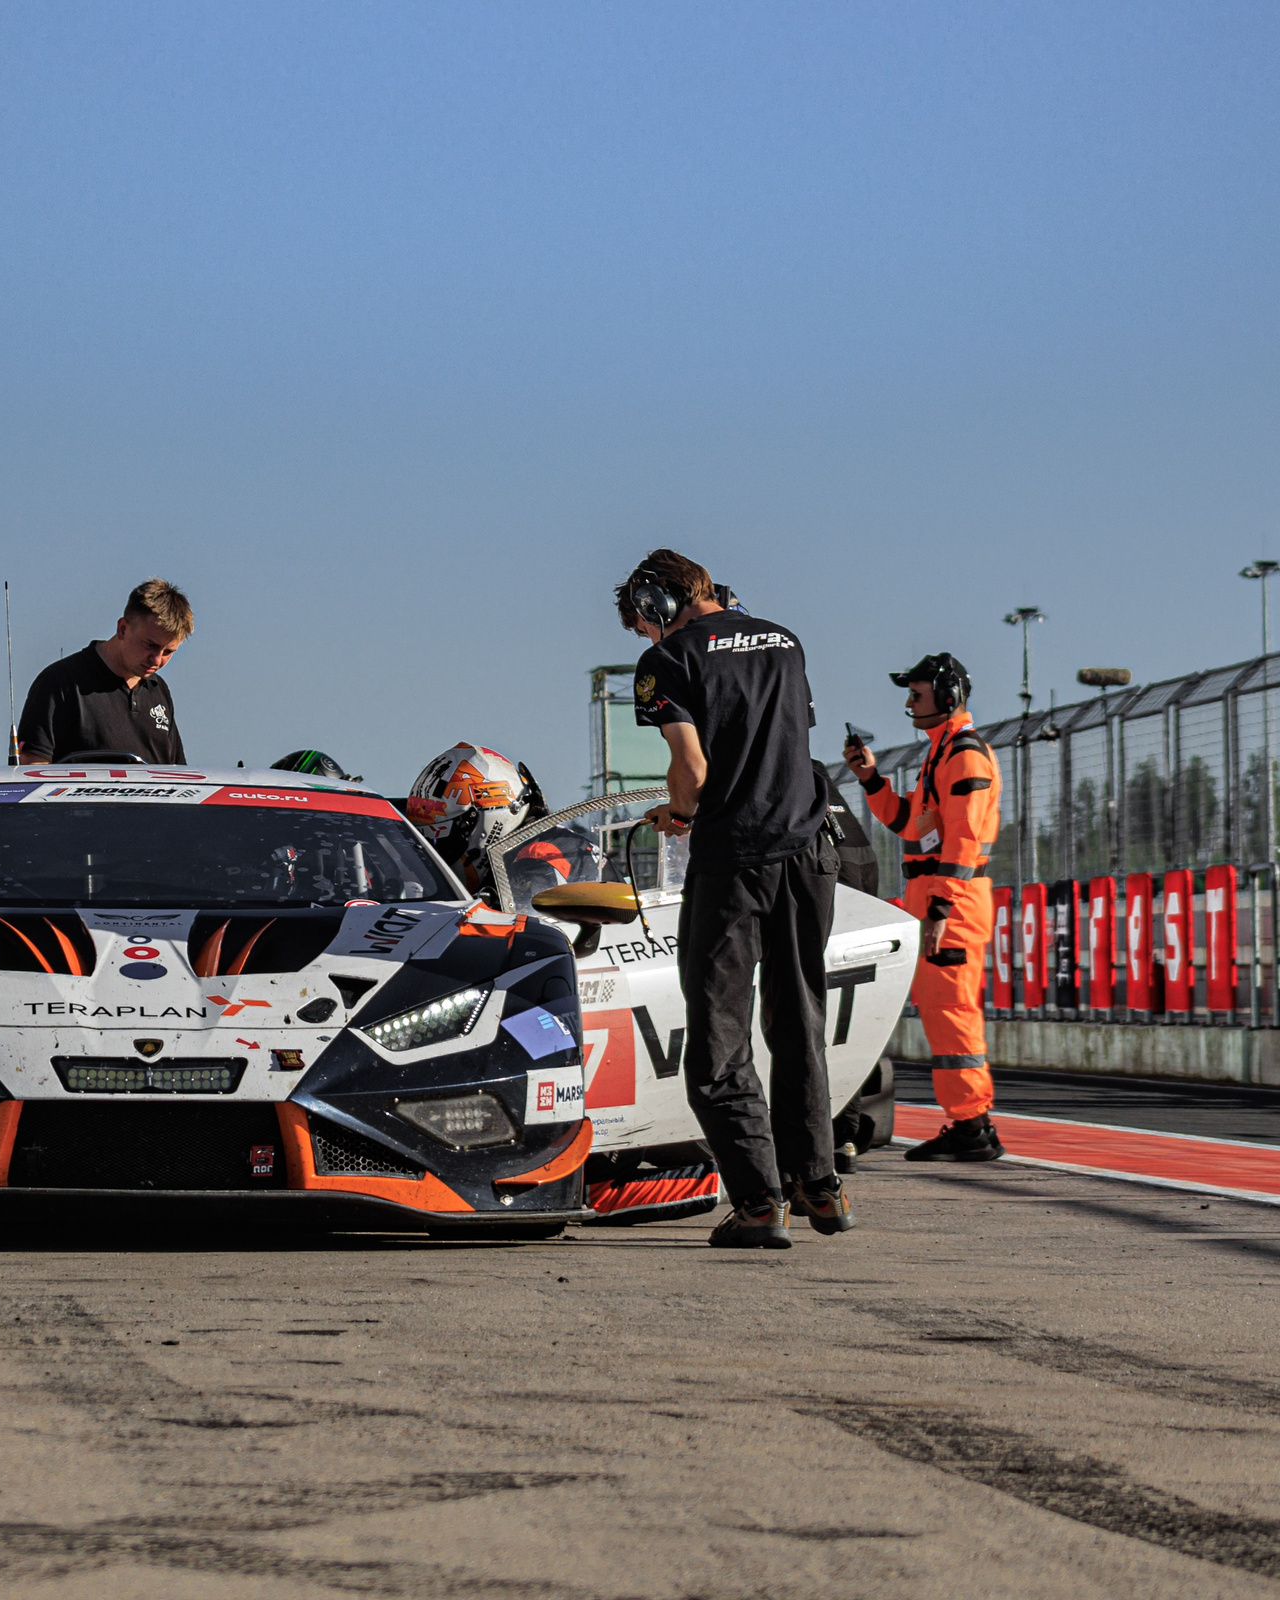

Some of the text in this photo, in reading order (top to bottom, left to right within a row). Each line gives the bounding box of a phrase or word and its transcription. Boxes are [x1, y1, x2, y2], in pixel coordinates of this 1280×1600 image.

[707, 632, 781, 653] iskra
[732, 642, 780, 652] motorsport
[229, 792, 308, 802] auto.ru
[24, 1002, 208, 1018] TERAPLAN
